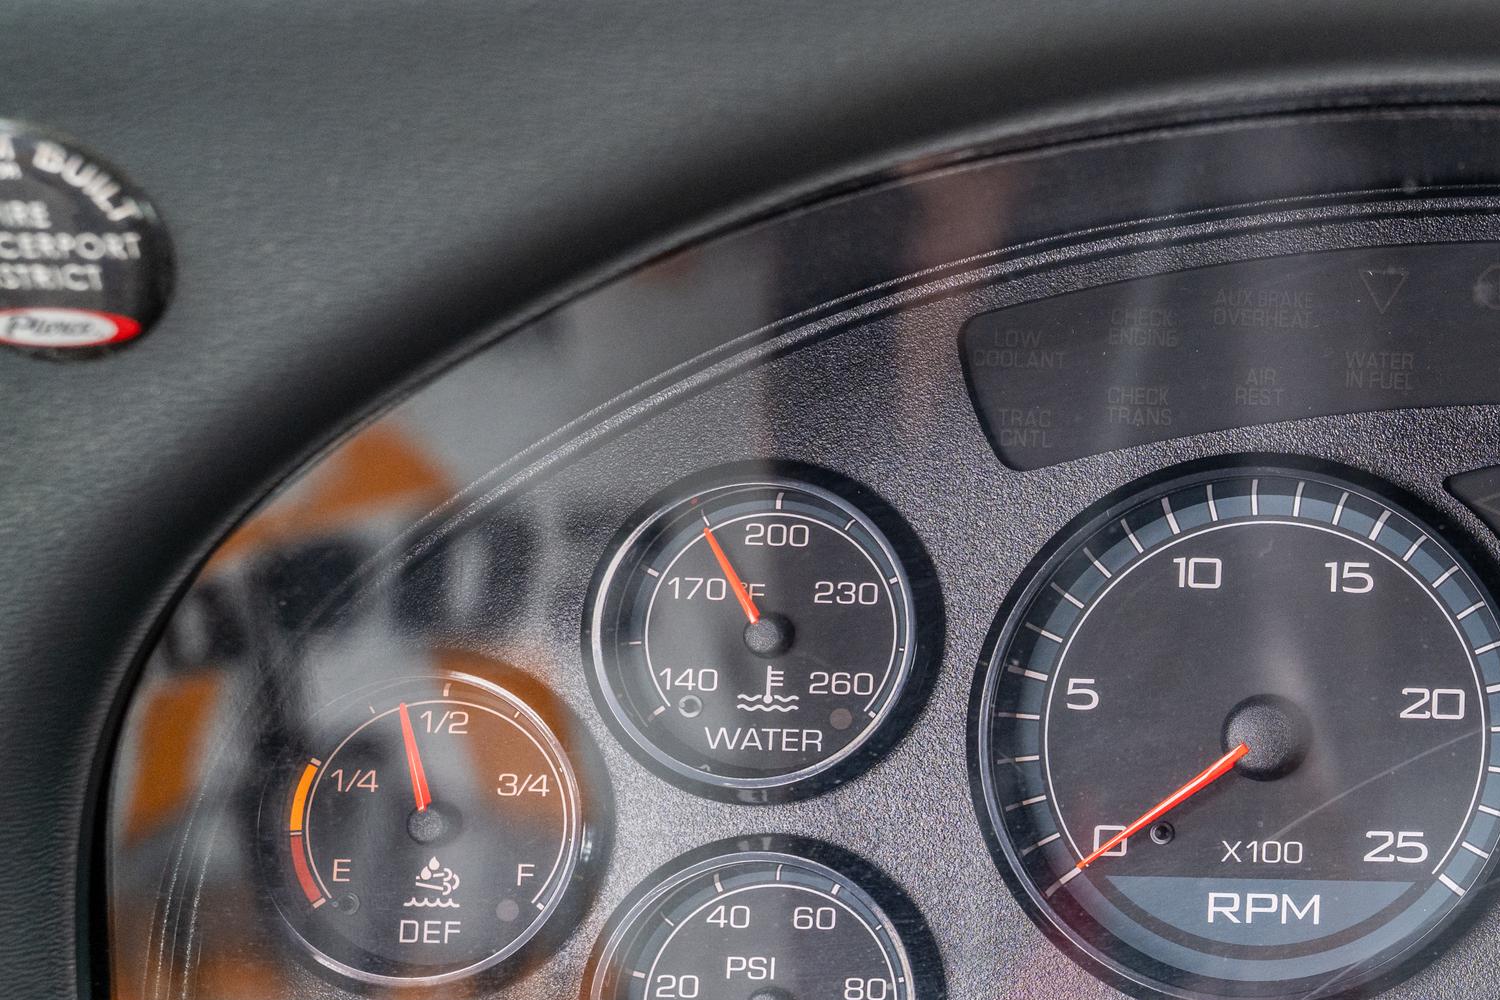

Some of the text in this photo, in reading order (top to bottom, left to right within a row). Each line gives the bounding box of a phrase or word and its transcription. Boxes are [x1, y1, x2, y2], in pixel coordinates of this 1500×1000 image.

[1111, 308, 1173, 327] CHECK
[1213, 308, 1314, 328] OVERHEAT
[993, 329, 1042, 348] LOW
[1107, 328, 1178, 348] ENGINE
[973, 351, 1067, 370] COOLANT
[1345, 351, 1414, 370] WATER
[1245, 368, 1277, 387] AIR
[1345, 370, 1414, 391] IN FUEL
[1107, 386, 1169, 406] CHECK
[1235, 388, 1285, 406] REST
[1106, 407, 1173, 426] TRANS
[745, 524, 809, 547] 200
[1173, 557, 1222, 589] 10
[1324, 562, 1374, 593] 15
[668, 577, 726, 601] 170
[814, 582, 879, 605] 230
[659, 668, 718, 691] 140
[809, 672, 874, 695] 260
[1066, 679, 1099, 710] 5
[1400, 688, 1465, 720] 20
[420, 710, 469, 735] 1/2
[705, 727, 822, 752] WATER
[330, 769, 379, 793] 1/4
[497, 773, 550, 797] 3/4
[1093, 825, 1128, 857] 0
[1221, 840, 1303, 865] X100
[1363, 830, 1429, 863] 25
[333, 859, 352, 882] E
[517, 863, 535, 886] F
[706, 906, 750, 929] 40
[793, 907, 837, 930] 60
[1207, 892, 1321, 926] RPM
[399, 920, 462, 944] DEF
[725, 957, 776, 980] PSI
[656, 975, 699, 998] 20
[844, 978, 887, 1000] 80
